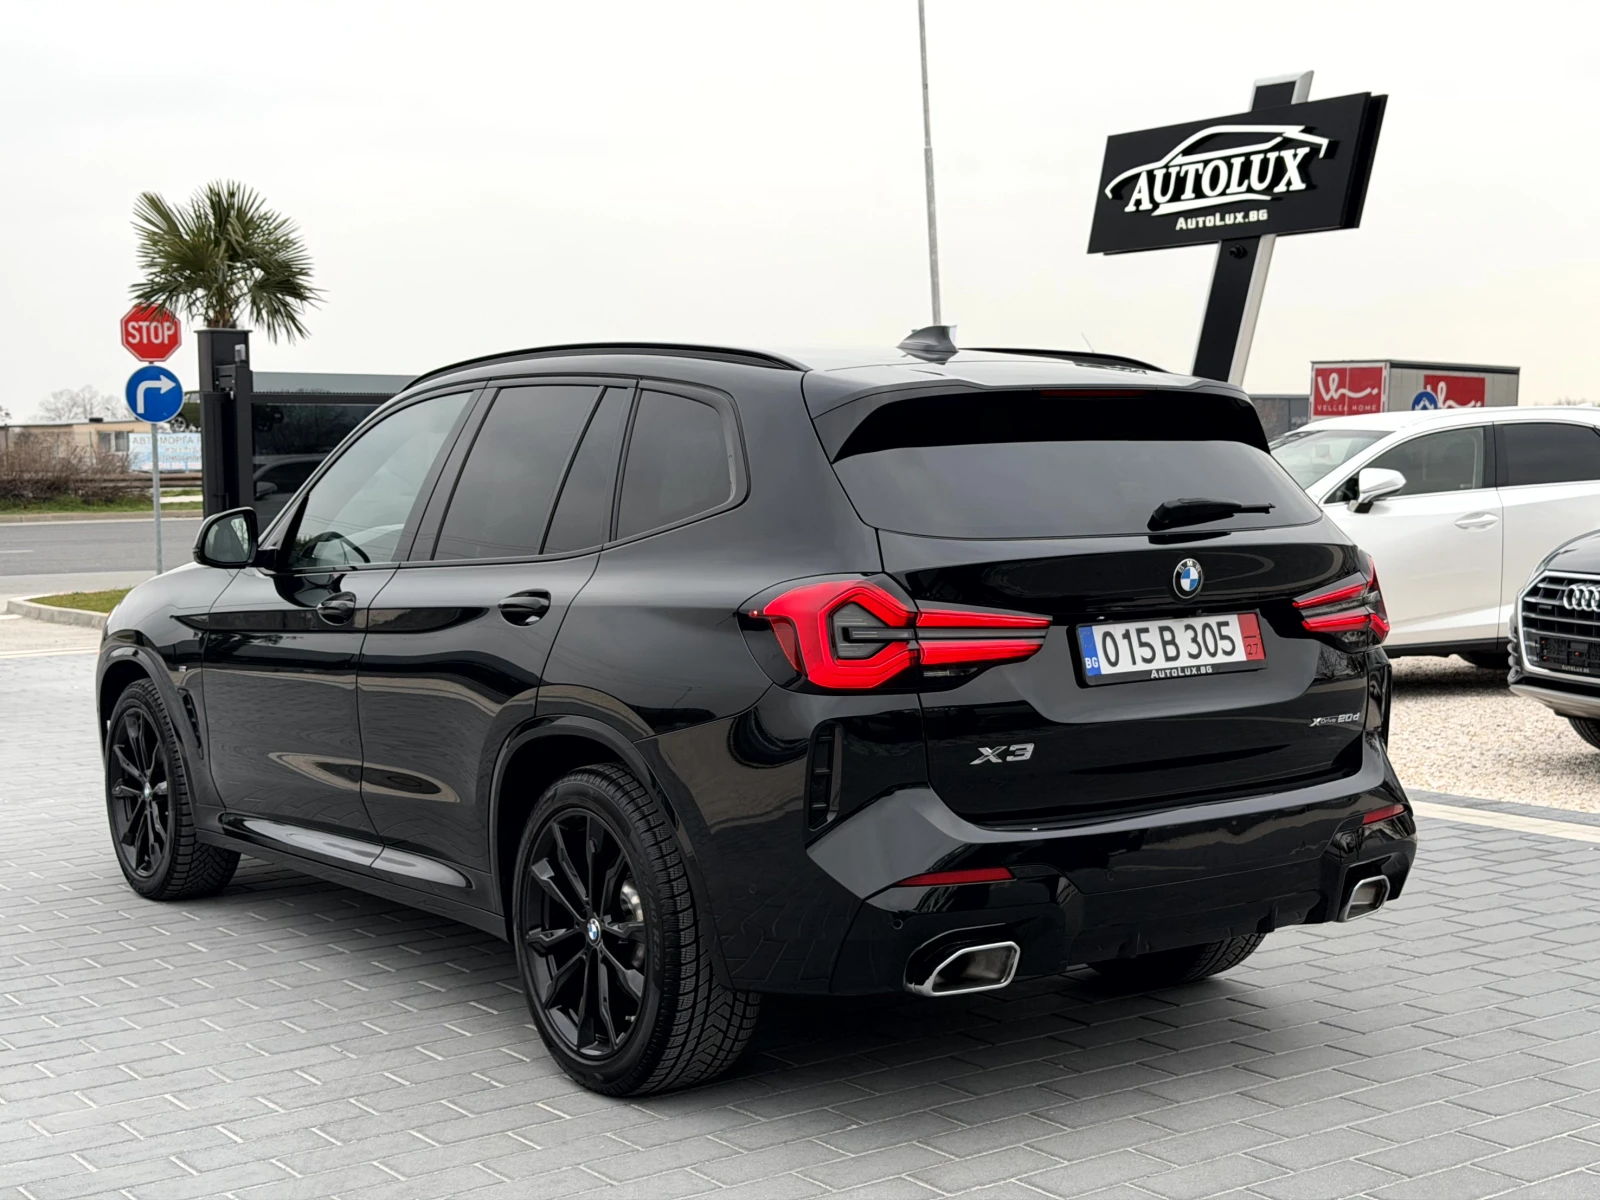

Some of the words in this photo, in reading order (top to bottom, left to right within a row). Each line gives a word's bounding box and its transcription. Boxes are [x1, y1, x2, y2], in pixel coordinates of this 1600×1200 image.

[1124, 147, 1310, 212] AUTOLUX
[128, 321, 175, 344] STOP
[1352, 404, 1377, 412] HOME
[132, 436, 195, 445] АВТМОРГА
[1177, 560, 1201, 574] BMW
[1246, 643, 1259, 656] 27
[1085, 656, 1099, 669] BG
[969, 742, 1035, 765] X3
